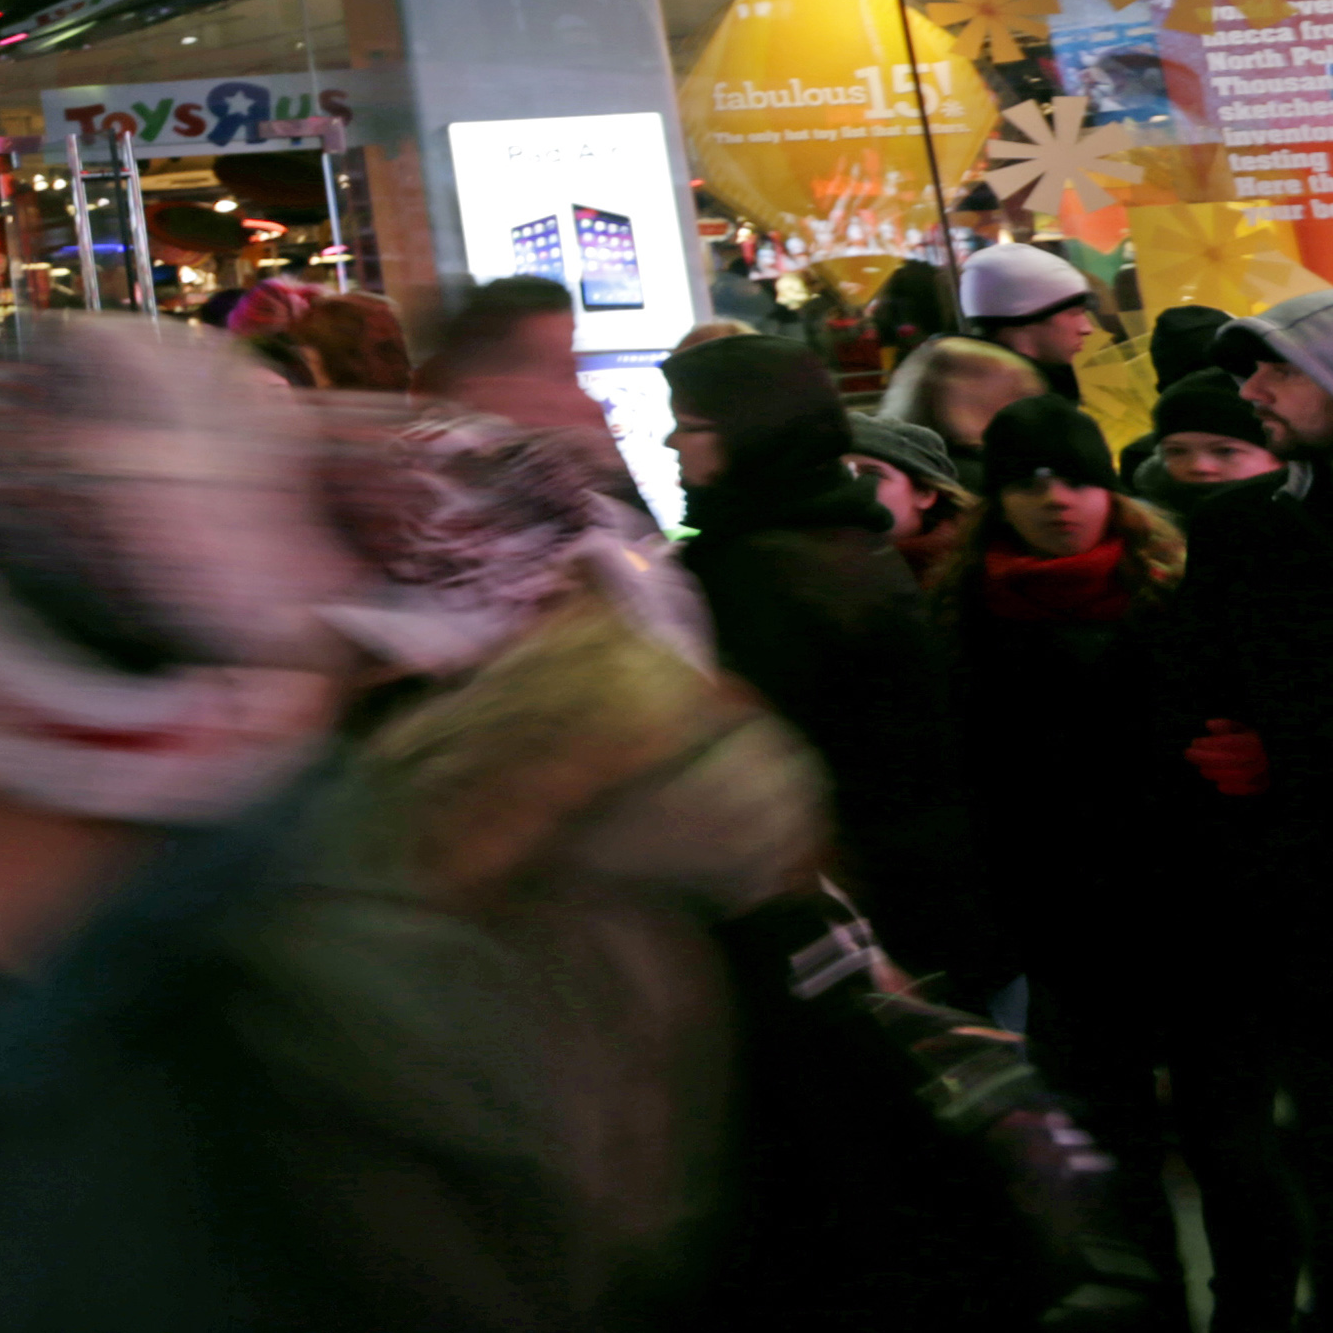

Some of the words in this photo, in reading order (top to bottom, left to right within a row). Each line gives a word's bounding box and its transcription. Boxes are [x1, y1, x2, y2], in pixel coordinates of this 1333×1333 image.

[1206, 47, 1287, 72] North
[712, 77, 868, 112] fabulous
[1228, 148, 1330, 173] testing
[1234, 175, 1303, 197] Here
